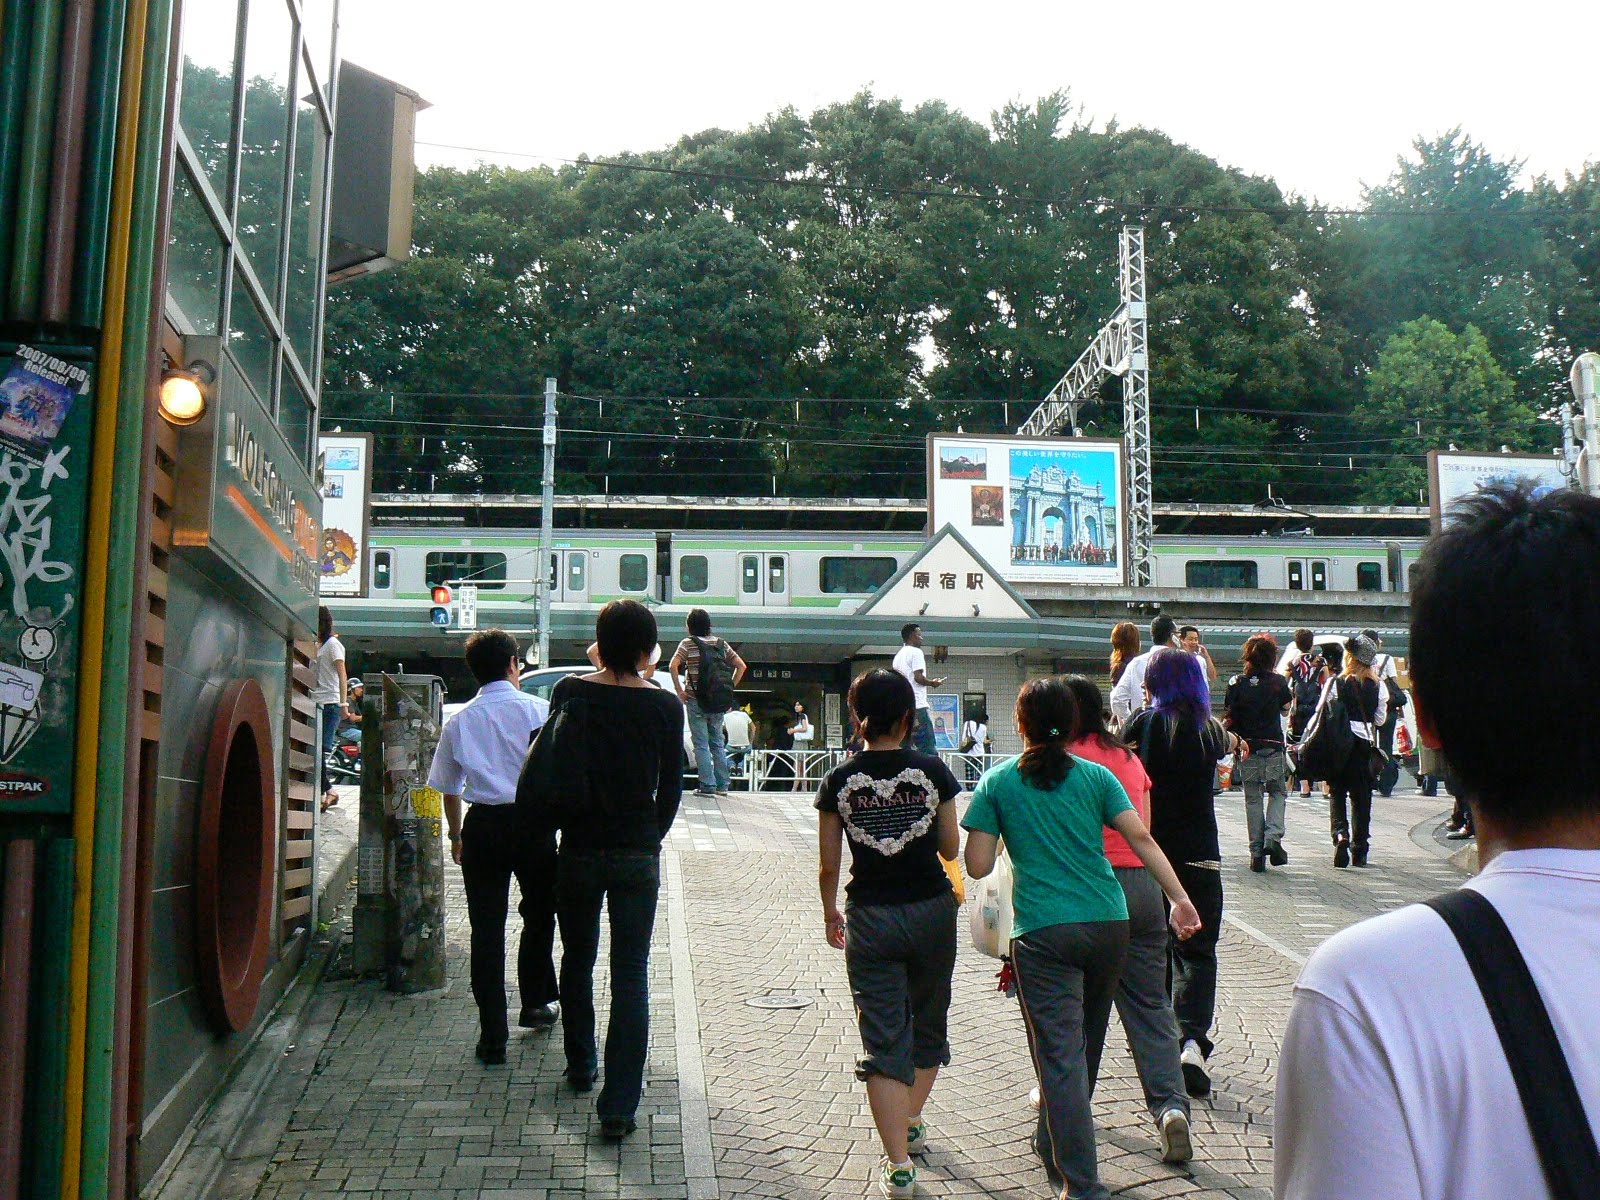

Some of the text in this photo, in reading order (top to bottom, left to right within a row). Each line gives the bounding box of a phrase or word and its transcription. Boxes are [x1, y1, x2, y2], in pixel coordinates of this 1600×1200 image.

[16, 344, 87, 383] 2007/08/08
[24, 359, 69, 386] Release!
[912, 571, 983, 590] 原宿駅
